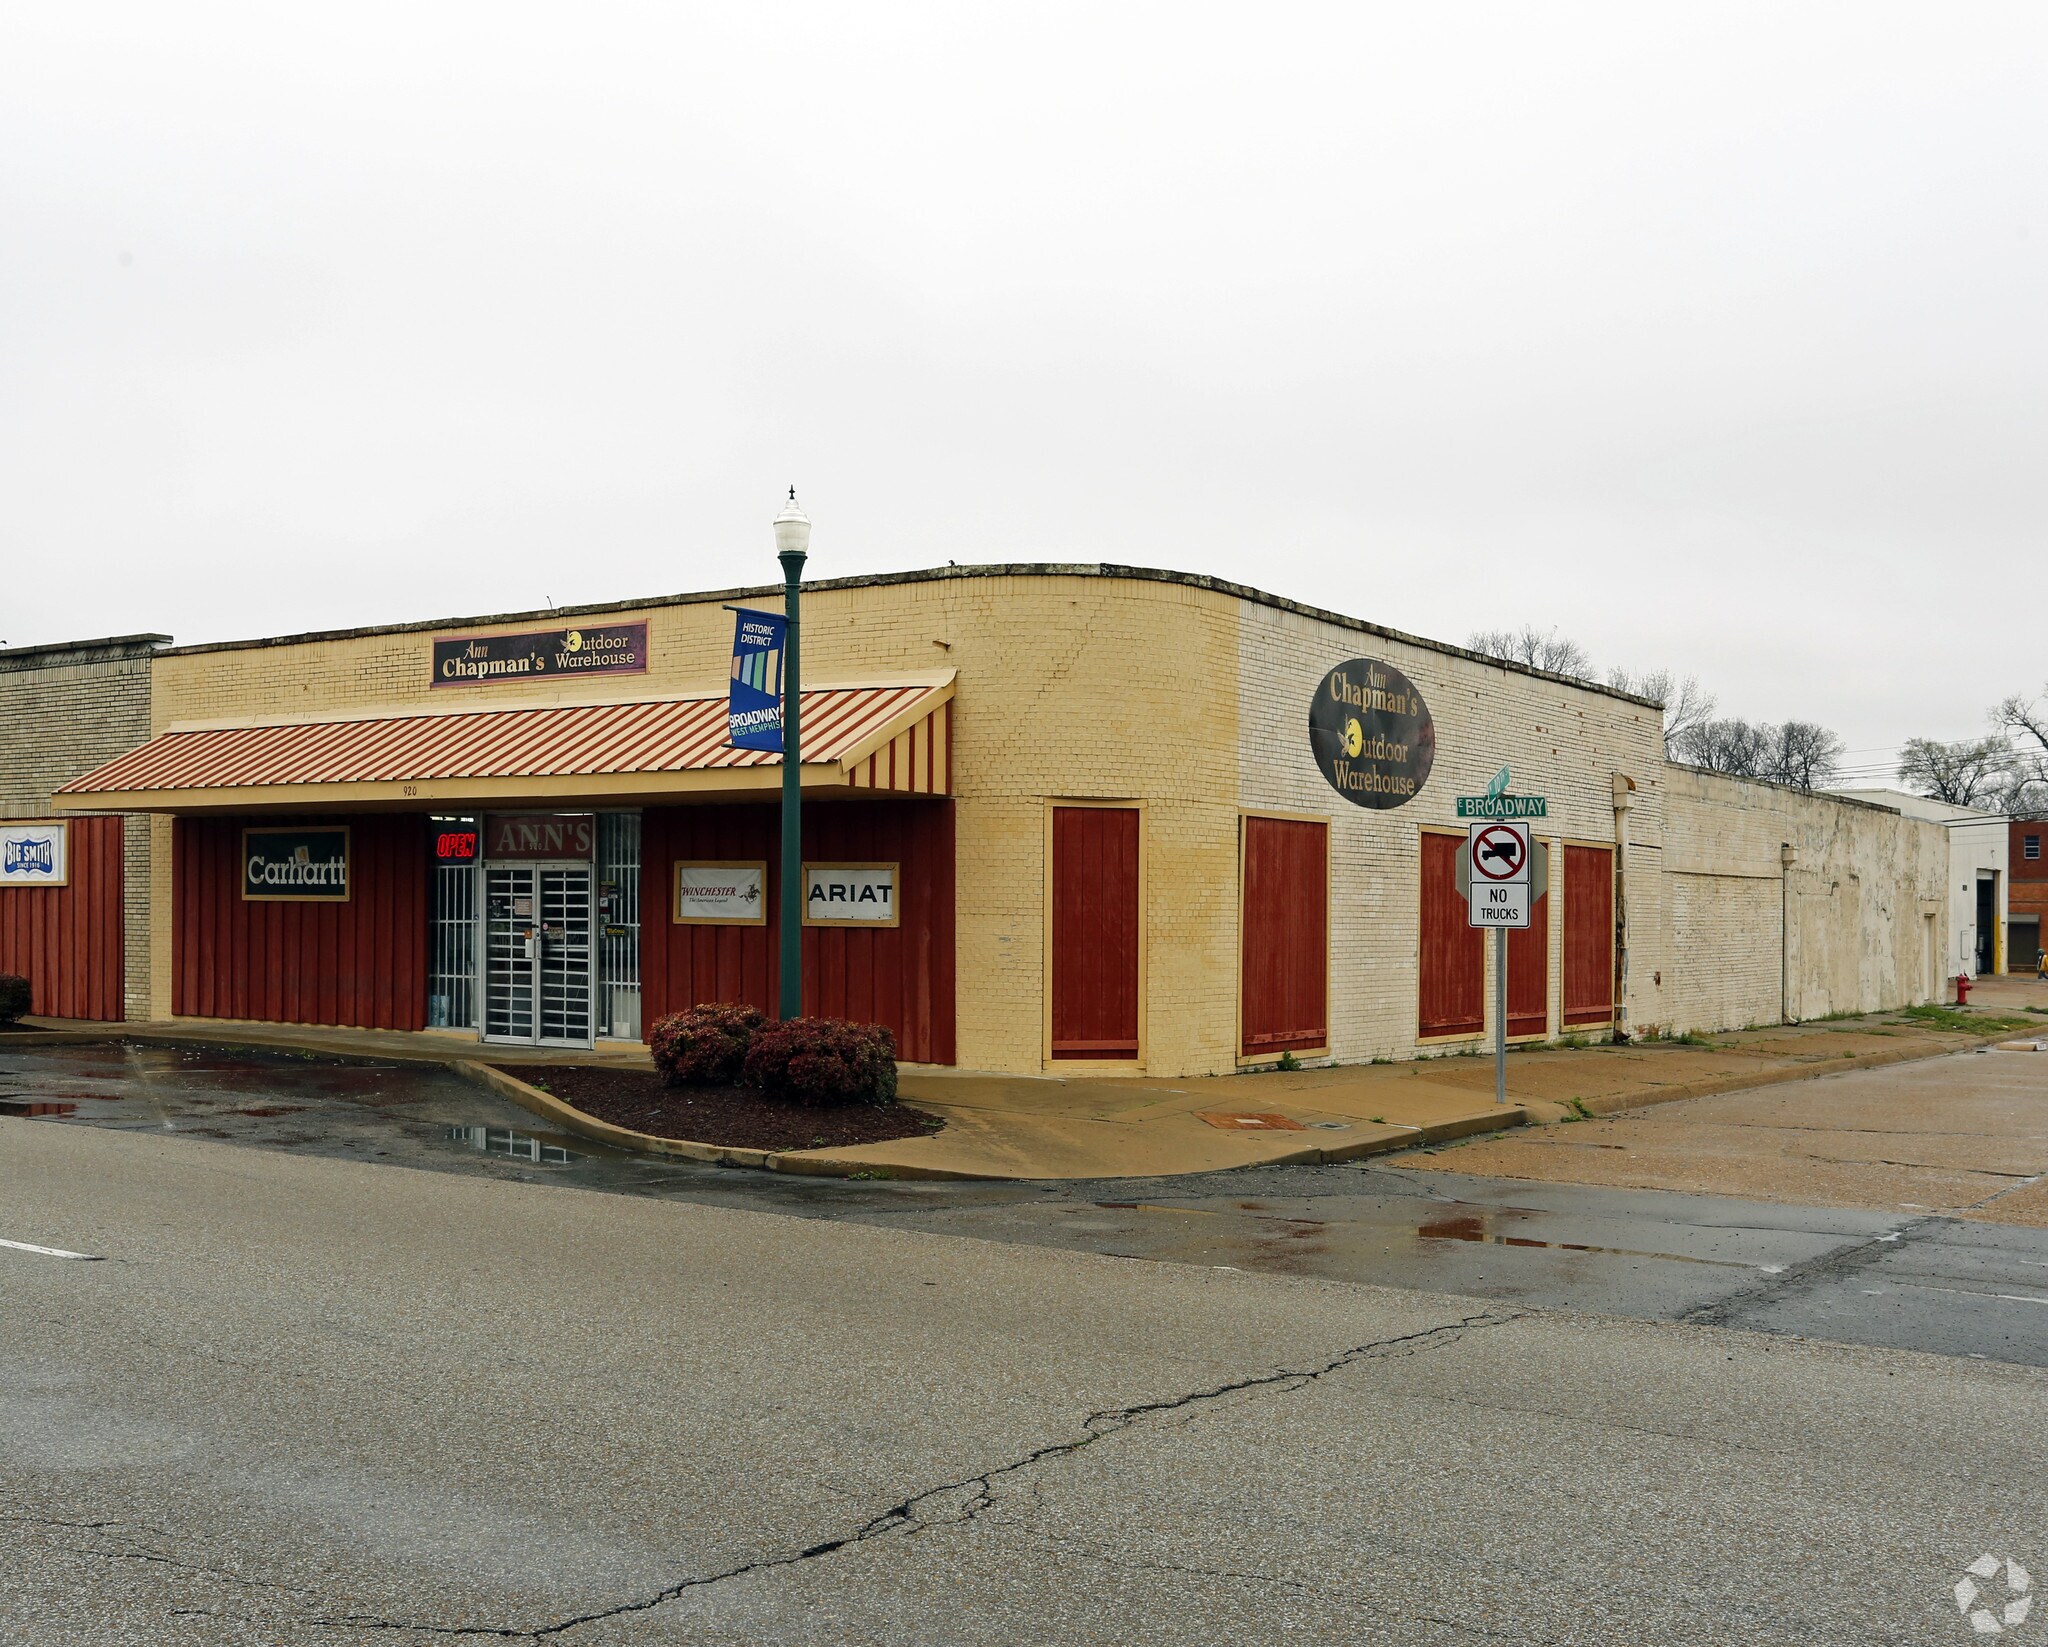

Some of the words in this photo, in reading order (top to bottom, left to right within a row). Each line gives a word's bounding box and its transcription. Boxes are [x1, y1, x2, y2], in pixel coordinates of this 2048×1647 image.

[742, 622, 775, 636] HISTORIC
[565, 631, 629, 653] Outdoor
[741, 633, 772, 646] DISTRICT
[463, 641, 489, 660] Ann
[555, 650, 635, 668] Warehouse
[442, 651, 545, 678] Chapman's
[1364, 663, 1386, 689] Ann
[1330, 671, 1418, 717] Chapman's
[729, 706, 780, 729] BROADWAY
[730, 726, 749, 737] WEST
[749, 720, 780, 735] MEMPHIS
[1345, 718, 1408, 763] Outdoor
[1333, 759, 1415, 796] Warehouse
[403, 785, 417, 796] 920
[1458, 799, 1463, 808] E
[1465, 798, 1544, 816] BROADWAY
[437, 834, 476, 858] OPEN
[496, 823, 591, 852] ANN'S
[7, 841, 21, 866] BIG
[24, 841, 50, 866] SMITH
[248, 855, 346, 885] Carhartt
[681, 886, 737, 897] WINCHESTER
[808, 884, 893, 903] ARIAT
[1489, 888, 1507, 903] NO
[1481, 908, 1519, 920] TRUCKS
